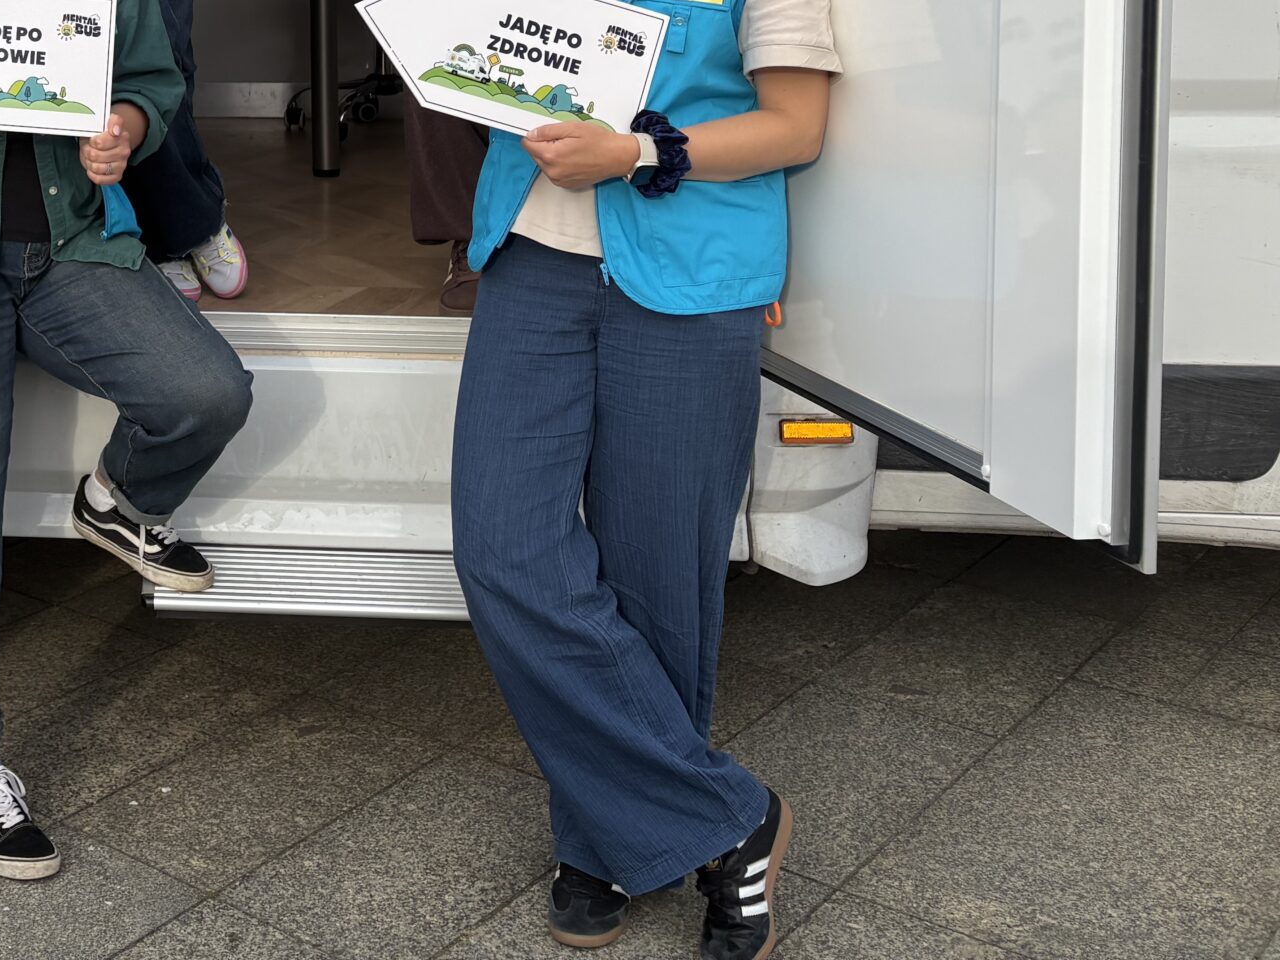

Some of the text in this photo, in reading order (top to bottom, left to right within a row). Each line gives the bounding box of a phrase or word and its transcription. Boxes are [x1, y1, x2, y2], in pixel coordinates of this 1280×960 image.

[62, 13, 98, 26] MENTAL
[16, 27, 42, 42] PO
[74, 23, 101, 37] BUS
[499, 13, 582, 49] JADĘ PO
[606, 25, 644, 44] MENTAL
[487, 34, 582, 75] ZDROWIE
[616, 37, 646, 57] BUS
